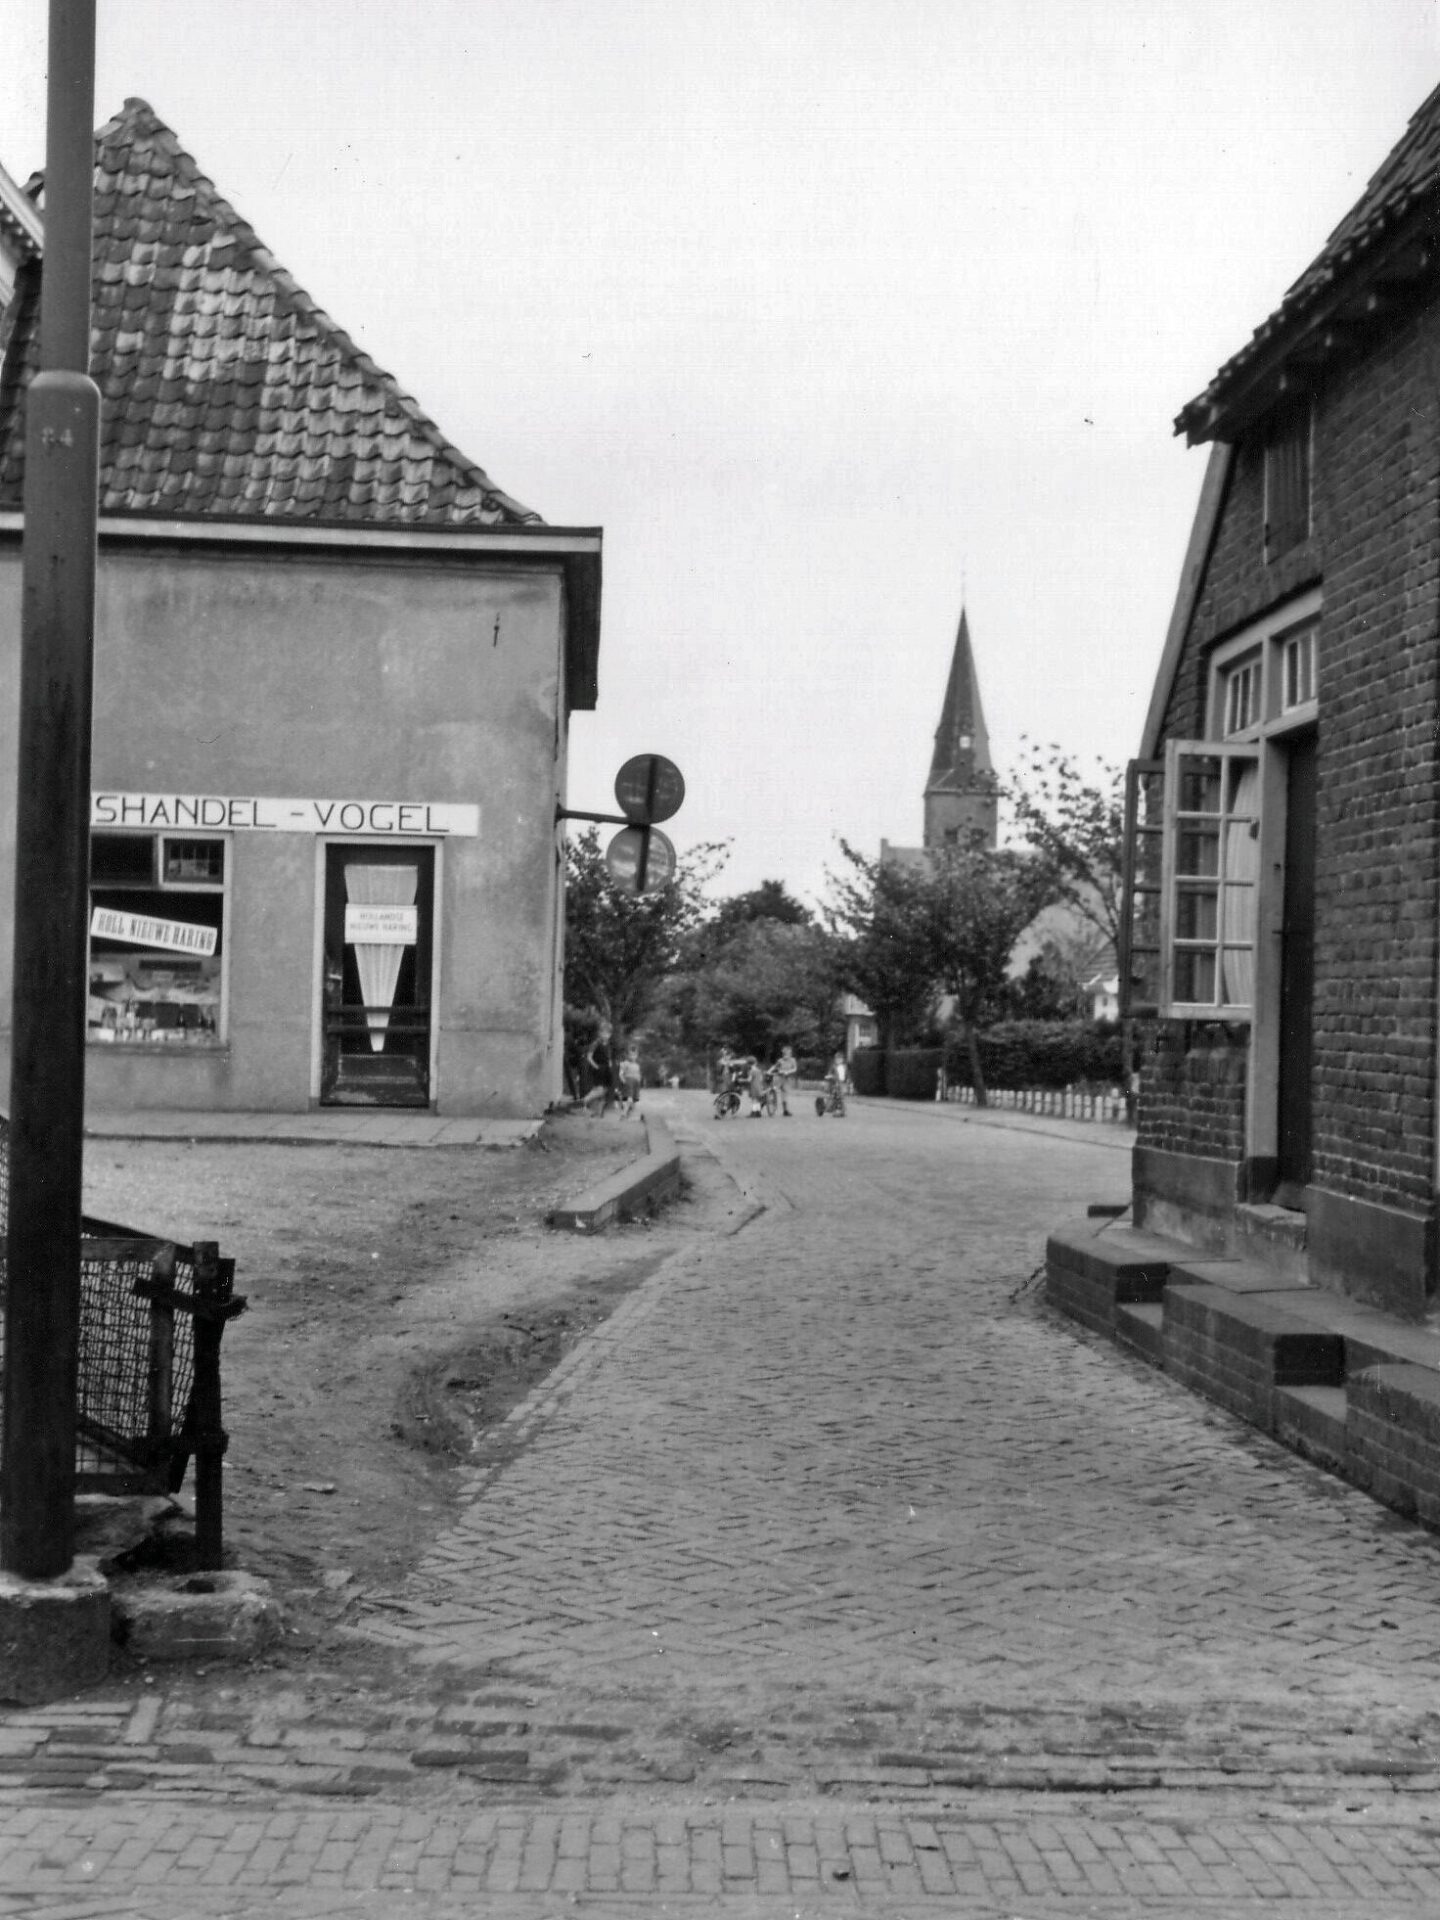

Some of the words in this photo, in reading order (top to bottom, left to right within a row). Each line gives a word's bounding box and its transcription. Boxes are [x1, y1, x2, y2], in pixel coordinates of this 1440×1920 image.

[96, 795, 277, 828] SHANDEL
[313, 802, 450, 833] VOGEL
[172, 925, 215, 951] HARING
